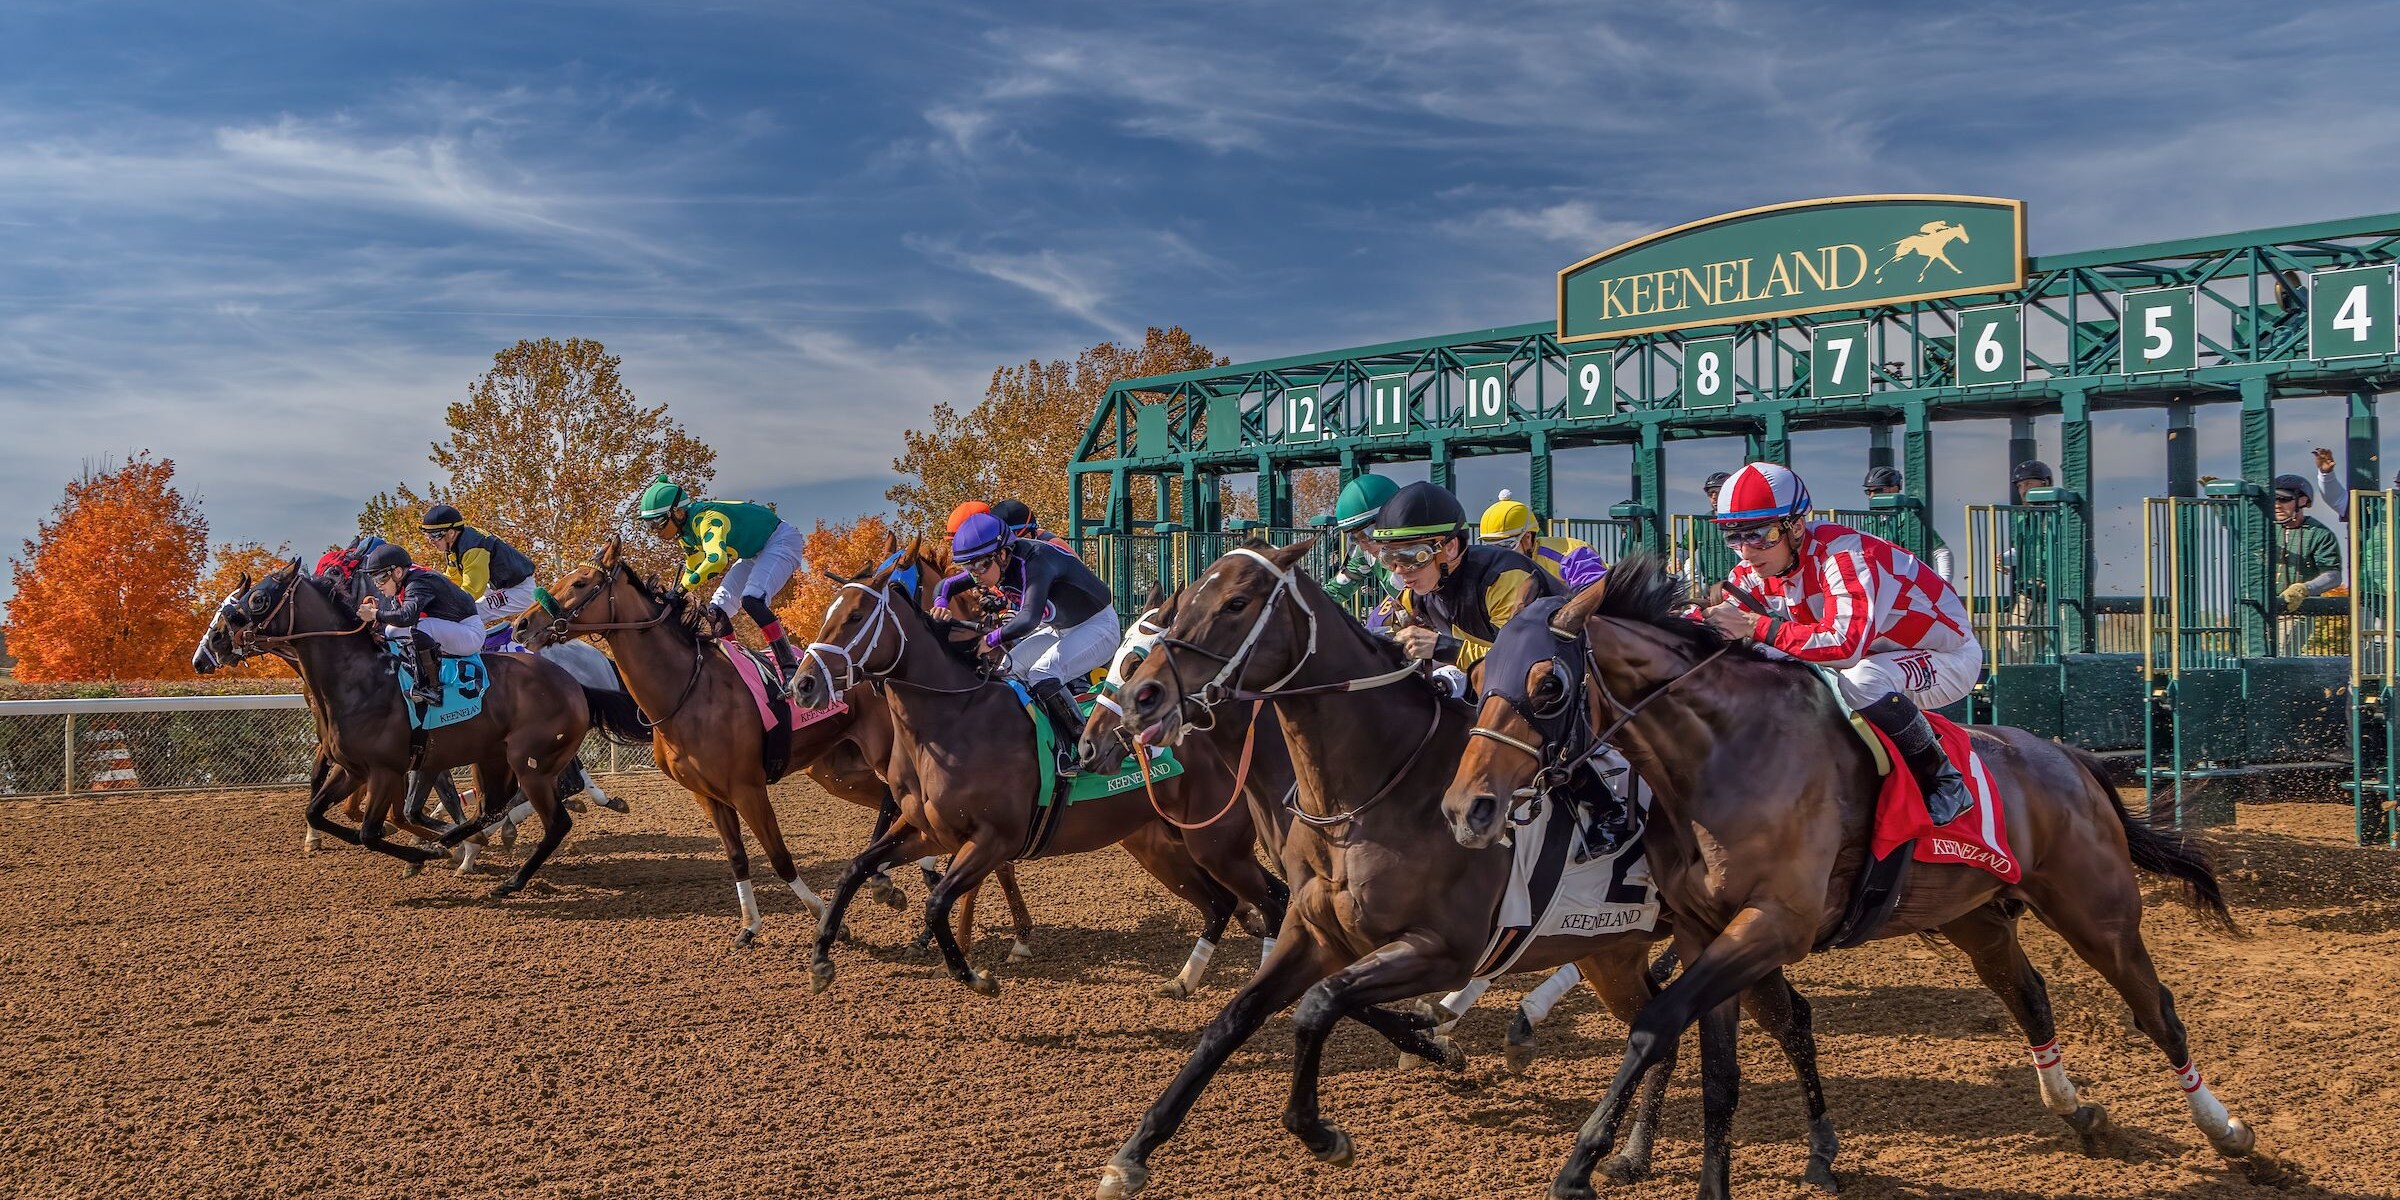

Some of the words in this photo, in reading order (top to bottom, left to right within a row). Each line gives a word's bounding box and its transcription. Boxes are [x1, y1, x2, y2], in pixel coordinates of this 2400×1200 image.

[1599, 243, 1868, 321] KEENELAND
[2143, 305, 2173, 360] 5
[2332, 285, 2372, 342] 4
[1827, 337, 1853, 385] 7
[1974, 322, 2004, 372] 6
[1579, 363, 1601, 406] 9
[1696, 351, 1720, 396] 8
[1289, 396, 1316, 434] 12
[1376, 386, 1401, 426] 11
[1469, 376, 1501, 418] 10
[458, 660, 484, 699] 9
[1968, 750, 2008, 858] 1
[1932, 838, 2012, 874] KEENELAND
[1560, 909, 1641, 931] KEENELAND
